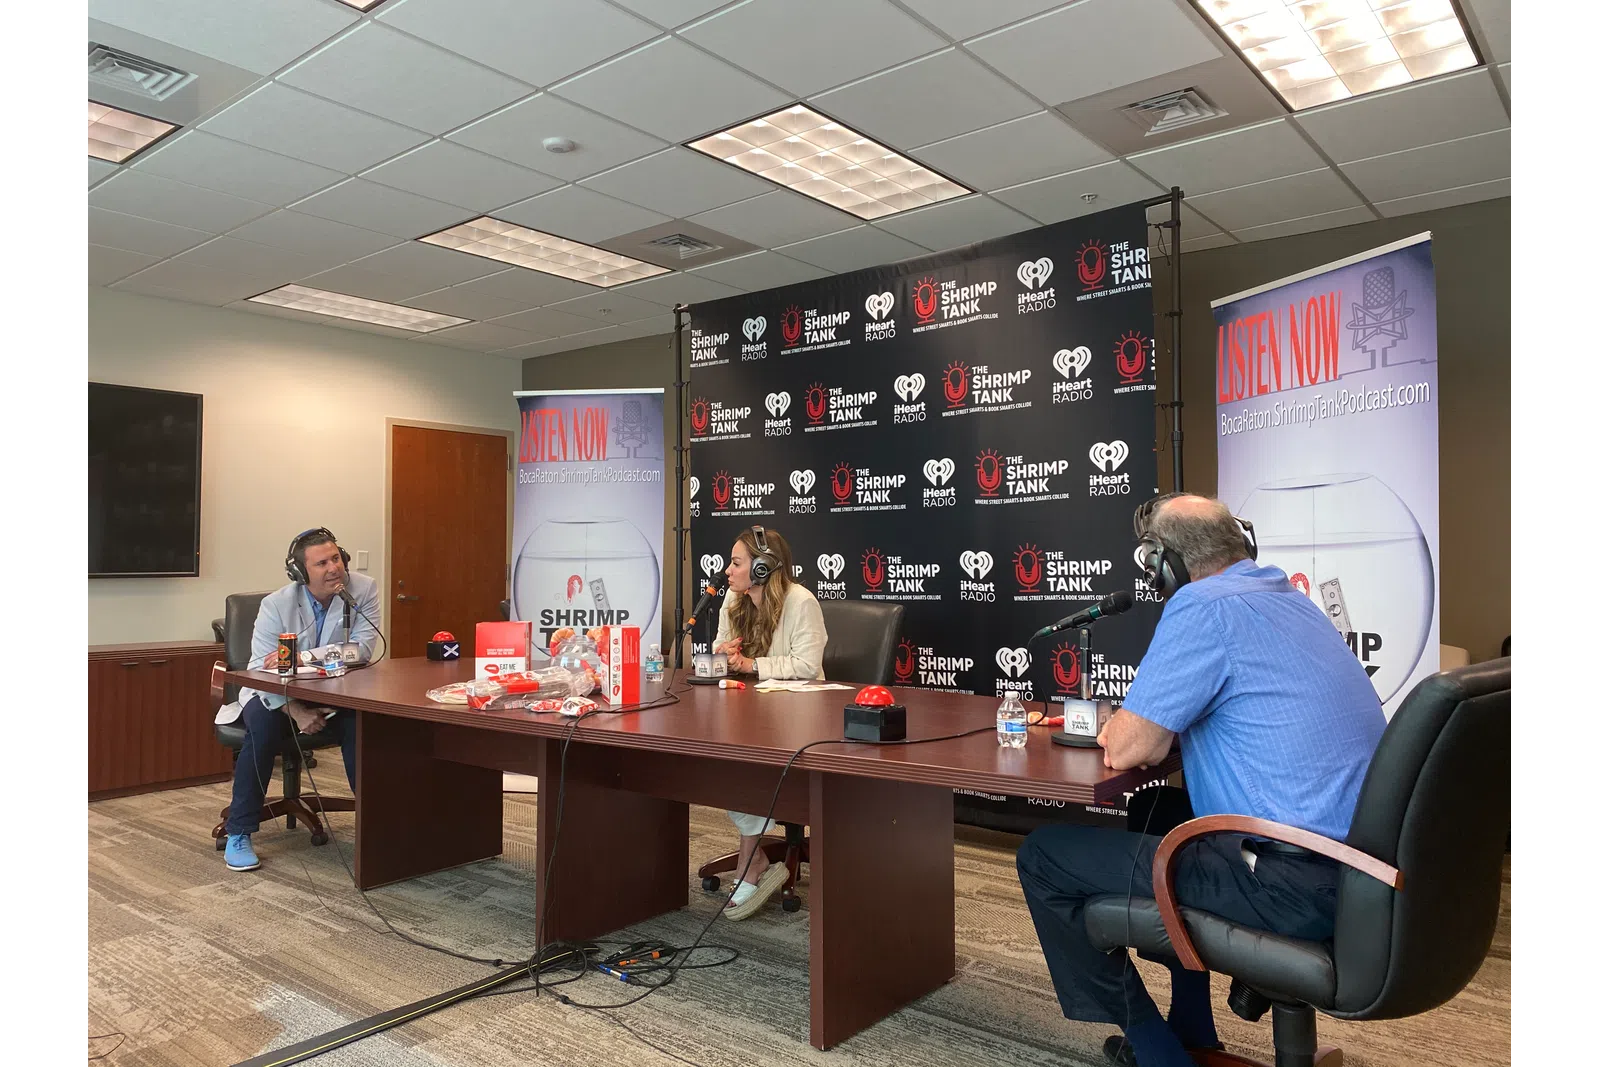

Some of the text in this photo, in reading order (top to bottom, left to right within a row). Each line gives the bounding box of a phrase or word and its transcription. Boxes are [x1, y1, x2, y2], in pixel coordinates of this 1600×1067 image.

[1110, 241, 1129, 253] THE
[941, 280, 956, 290] THE
[941, 282, 997, 305] SHRIMP
[1018, 287, 1055, 304] iHeart
[941, 298, 980, 319] TANK
[1018, 298, 1056, 314] RADIO
[805, 309, 817, 317] THE
[805, 311, 850, 331] SHRIMP
[865, 319, 895, 332] iHeart
[691, 333, 729, 349] SHRIMP
[805, 327, 837, 344] TANK
[865, 329, 895, 341] RADIO
[742, 341, 767, 353] iHeart
[1218, 308, 1281, 404] LISTEN
[1290, 290, 1342, 388] NOW
[691, 347, 717, 361] TANK
[742, 351, 767, 361] RADIO
[972, 366, 988, 374] THE
[972, 369, 1031, 389] SHRIMP
[1053, 378, 1092, 393] iHeart
[829, 387, 842, 396] THE
[972, 388, 1013, 404] TANK
[1053, 389, 1093, 404] RADIO
[829, 391, 877, 409] SHRIMP
[711, 407, 751, 422] SHRIMP
[829, 407, 862, 422] TANK
[894, 402, 926, 414] iHeart
[1221, 381, 1430, 436] BocaRaton.ShrimpTankPodcast.com
[765, 418, 791, 428] iHeart
[894, 412, 926, 424] RADIO
[711, 421, 739, 434] TANK
[765, 427, 792, 437] RADIO
[519, 407, 609, 463] LISTEN NOW
[1006, 456, 1023, 464] THE
[520, 466, 661, 486] BocaRaton.ShrimpTankPodcast.com
[1006, 460, 1068, 480] SHRIMP
[856, 475, 906, 490] SHRIMP
[1090, 473, 1129, 486] iHeart
[733, 483, 775, 496] SHRIMP
[923, 487, 955, 498] iHeart
[1006, 478, 1049, 495] TANK
[1090, 484, 1130, 496] RADIO
[733, 497, 762, 509] TANK
[789, 496, 815, 505] iHeart
[856, 490, 890, 504] TANK
[923, 497, 956, 507] RADIO
[789, 505, 816, 513] RADIO
[1045, 552, 1064, 560] THE
[888, 564, 940, 578] SHRIMP
[1046, 560, 1112, 576] SHRIMP
[818, 581, 845, 590] iHeart
[888, 579, 925, 592] TANK
[961, 580, 994, 592] iHeart
[1047, 577, 1093, 592] TANK
[817, 591, 846, 599] RADIO
[961, 591, 996, 602] RADIO
[540, 609, 629, 626] SHRIMP
[918, 647, 933, 656] THE
[919, 656, 974, 671] SHRIMP
[1091, 654, 1104, 663] HE
[919, 671, 957, 686] TANK
[1091, 664, 1139, 680] SHRIM
[996, 678, 1033, 691] iHeart
[975, 791, 990, 799] SMARTS
